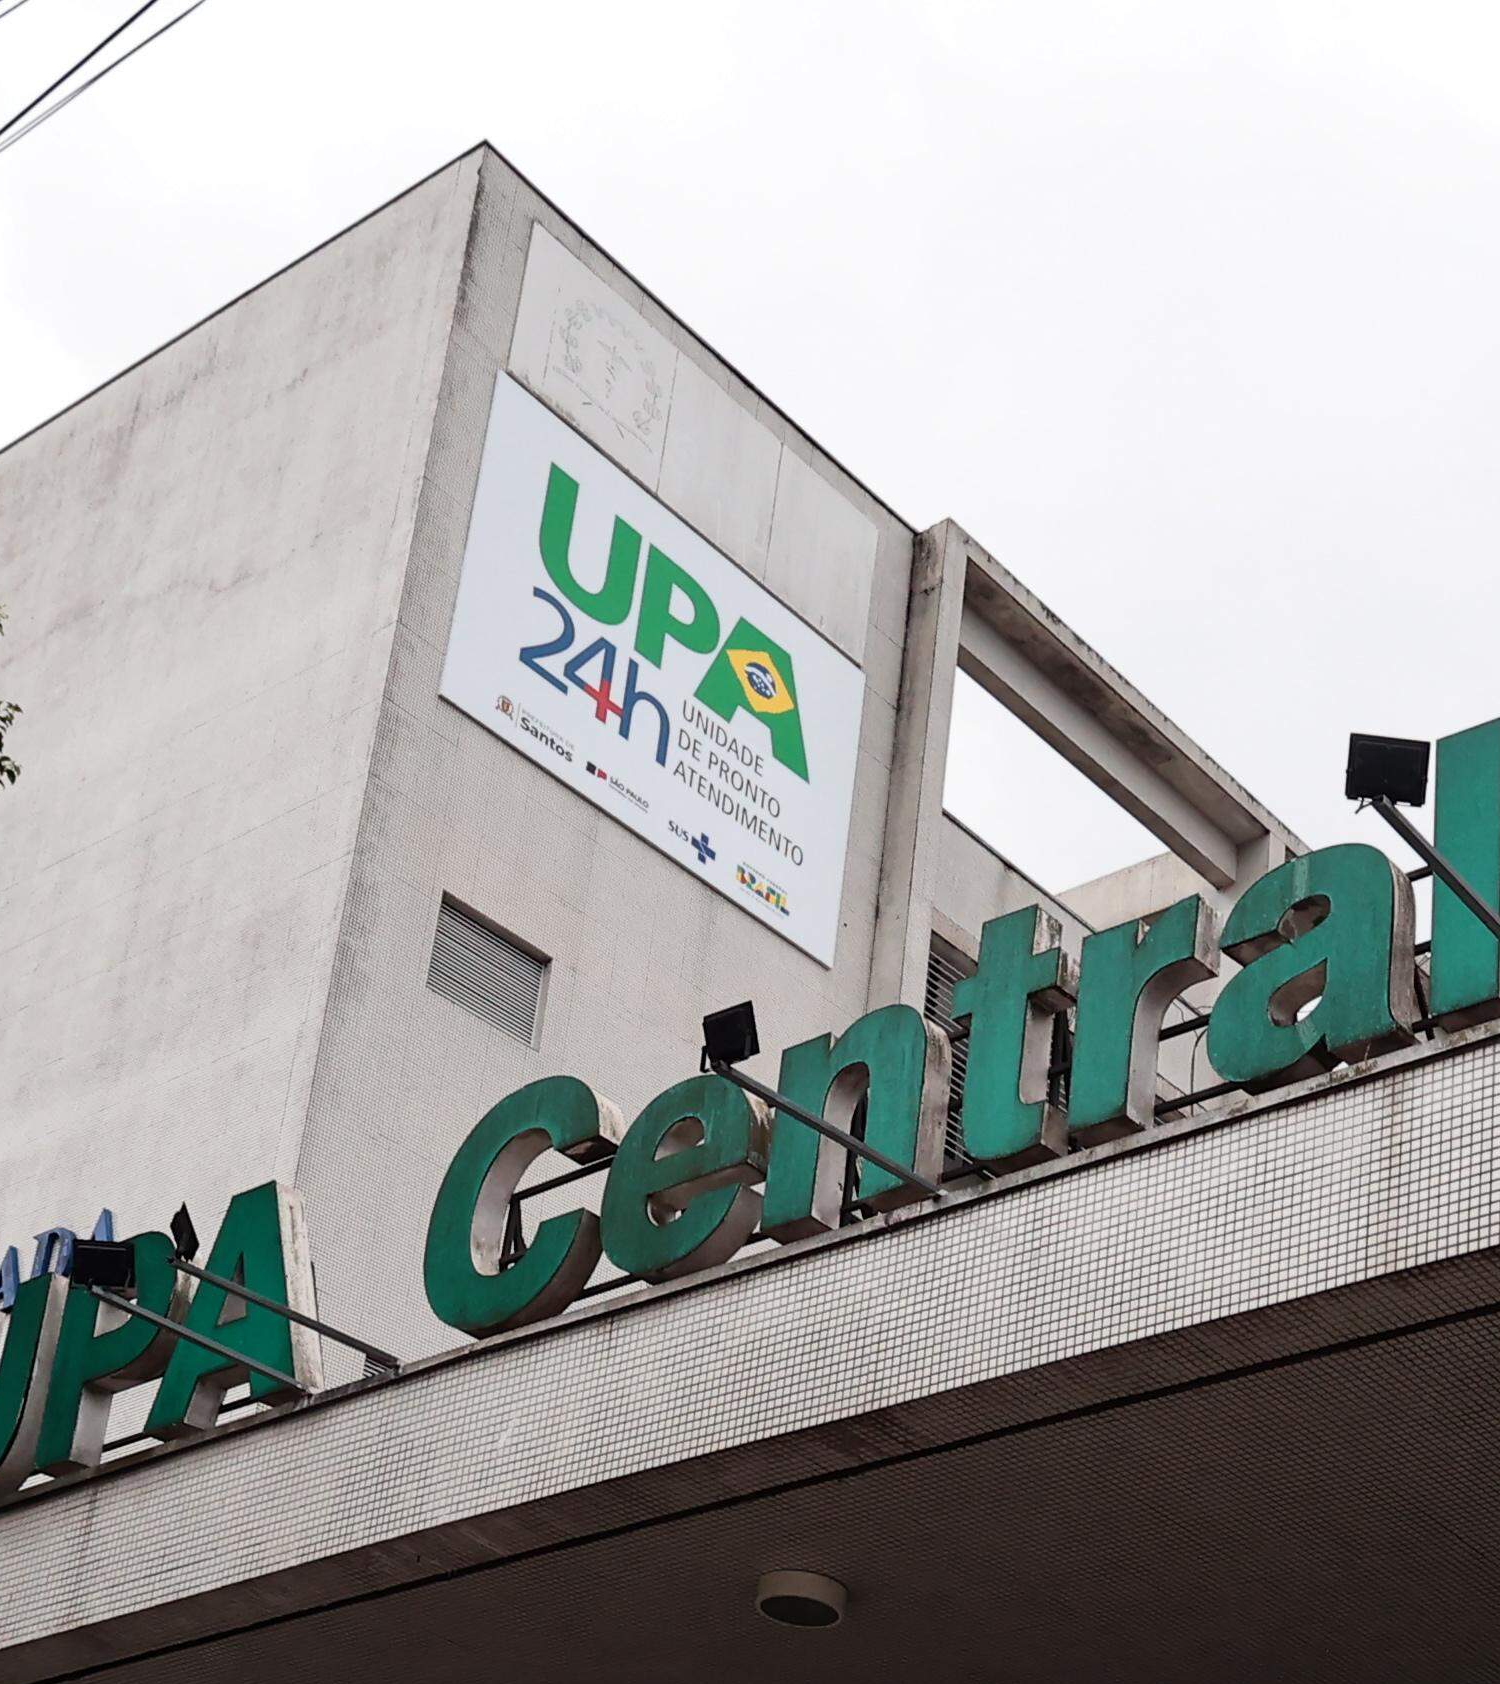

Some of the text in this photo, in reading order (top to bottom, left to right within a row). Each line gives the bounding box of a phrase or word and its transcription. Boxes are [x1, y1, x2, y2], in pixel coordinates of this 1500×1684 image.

[538, 461, 810, 785] UPA
[518, 585, 671, 769] 24h
[519, 714, 574, 763] Santos
[677, 728, 703, 763] DE
[708, 752, 782, 819] PRONTO
[682, 699, 766, 777] UNIDADE
[667, 819, 690, 843] SUS
[672, 760, 805, 867] ATENDIMENTO
